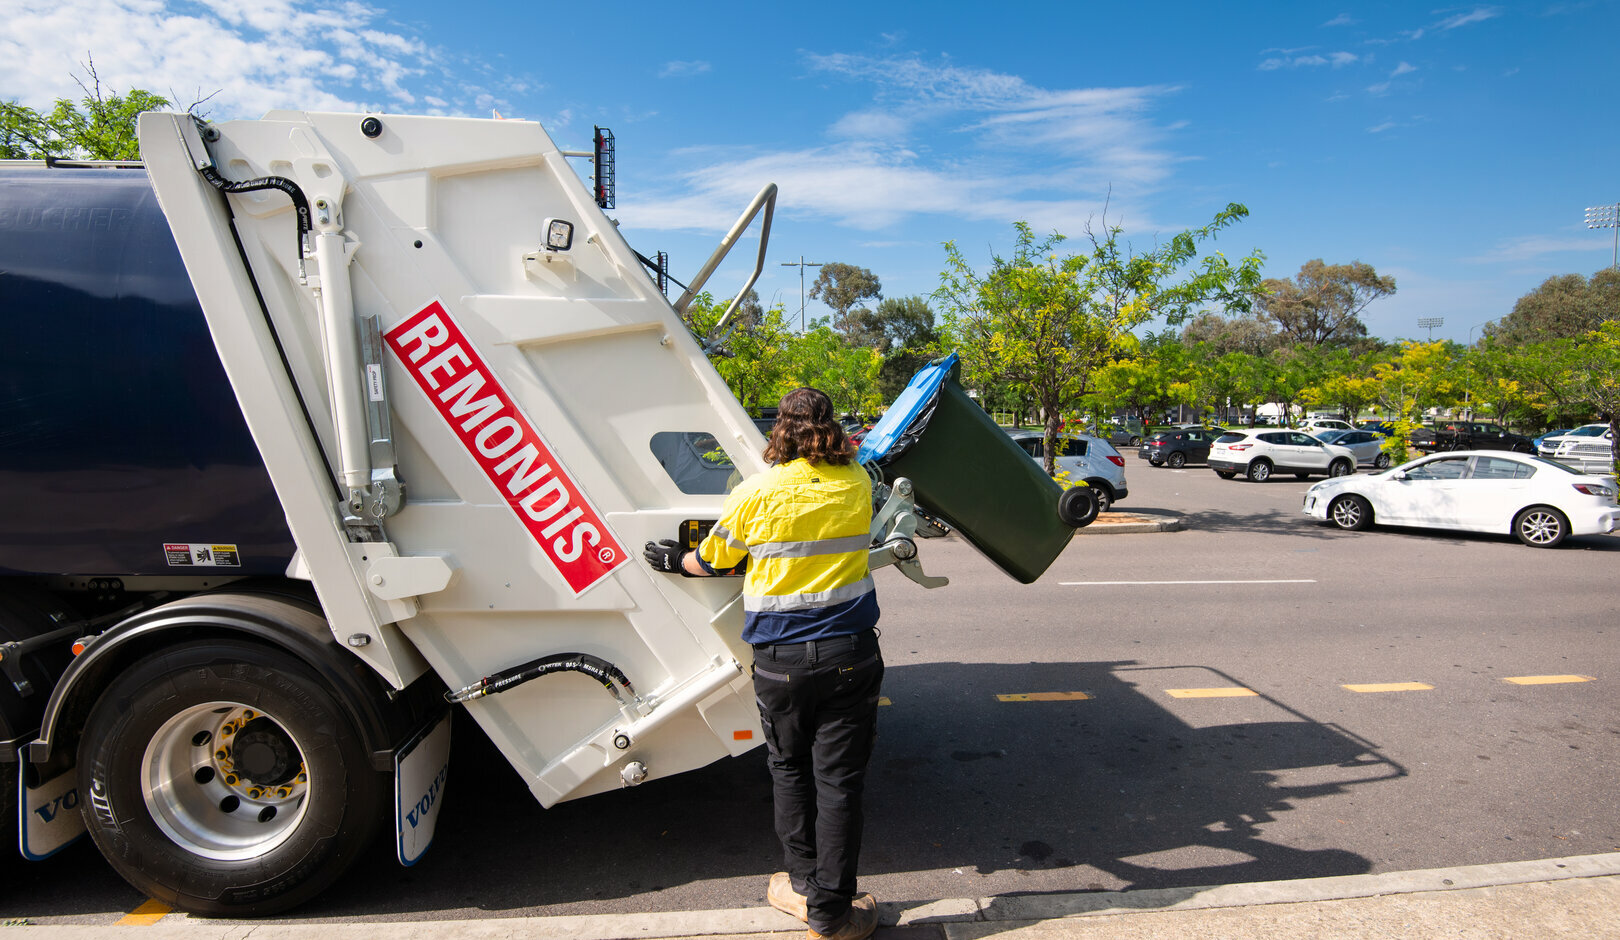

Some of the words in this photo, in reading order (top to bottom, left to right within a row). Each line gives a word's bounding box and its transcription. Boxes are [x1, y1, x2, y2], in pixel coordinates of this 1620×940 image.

[395, 312, 602, 564] REMONDIS
[495, 673, 522, 688] PRESSURE
[405, 763, 448, 829] VOLVO
